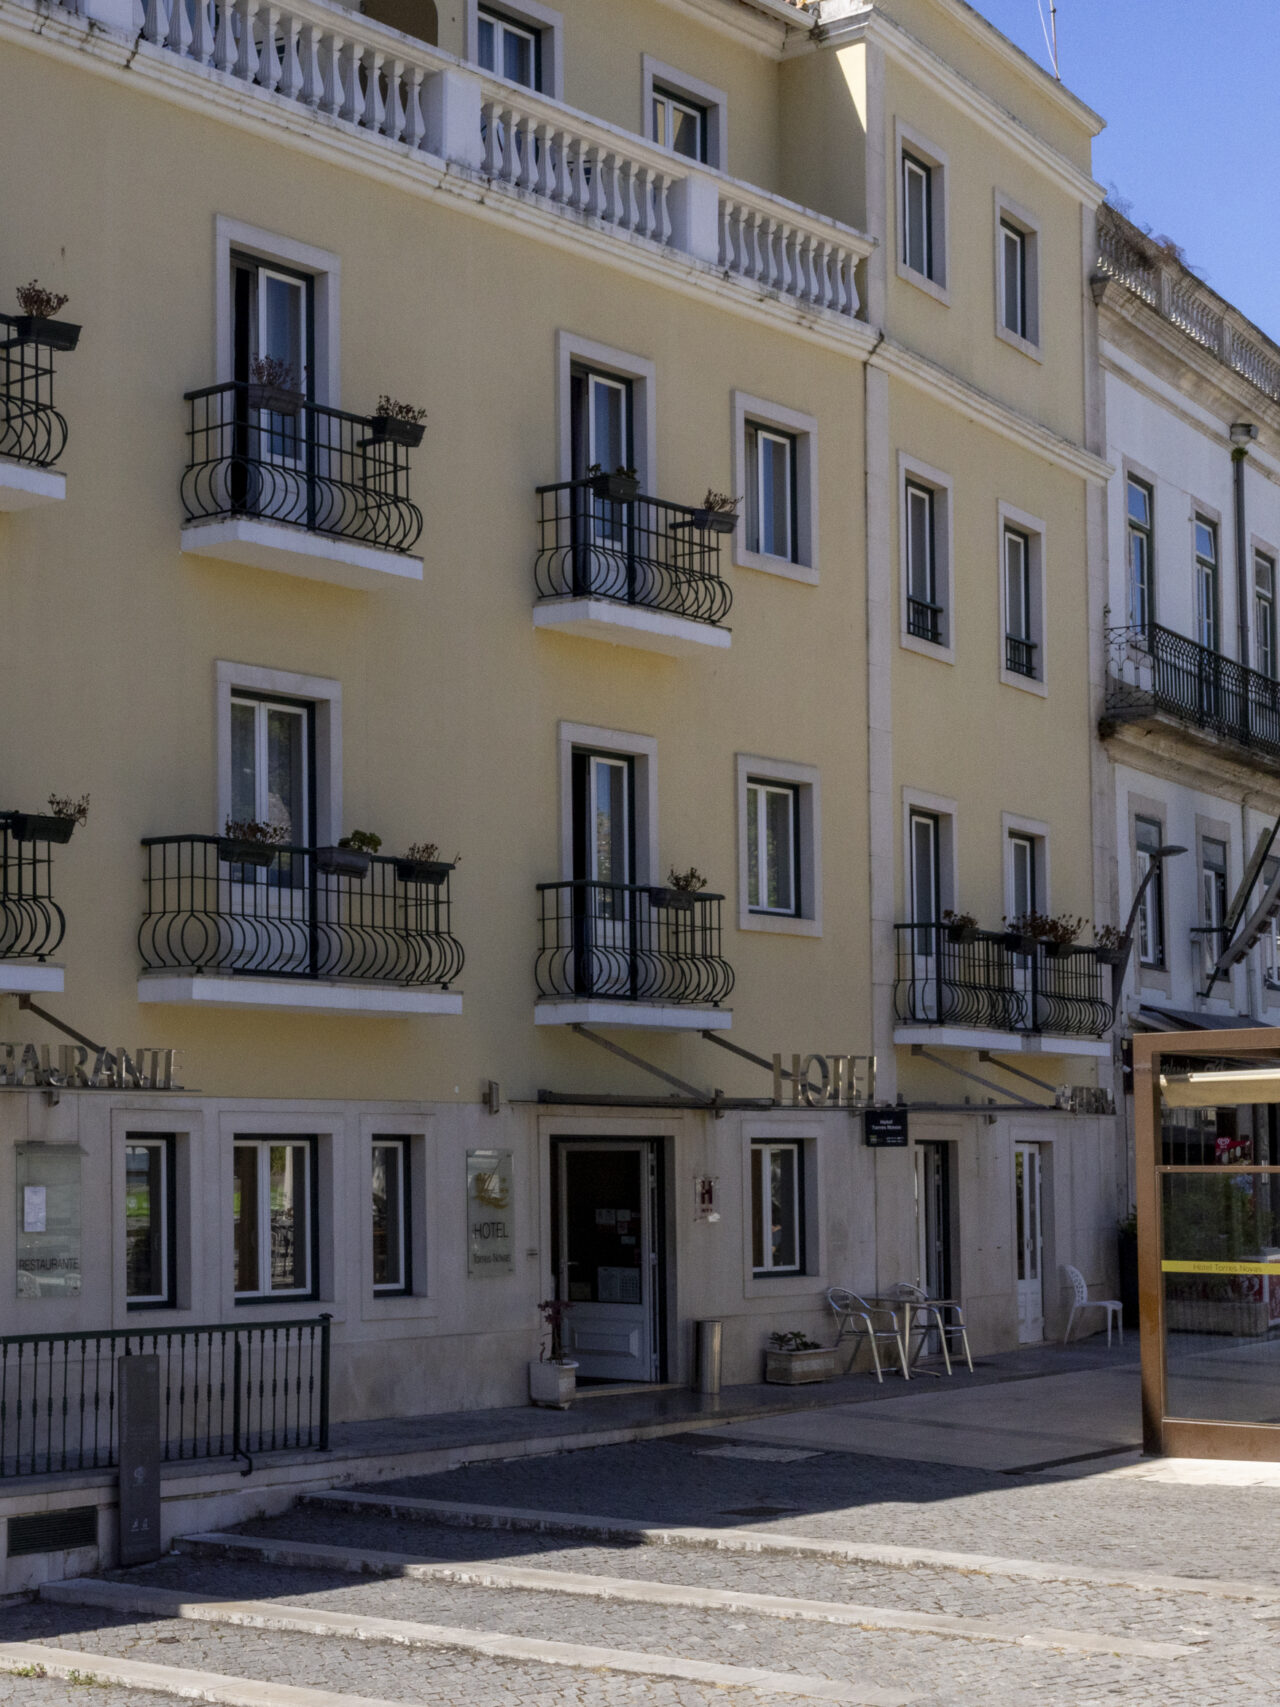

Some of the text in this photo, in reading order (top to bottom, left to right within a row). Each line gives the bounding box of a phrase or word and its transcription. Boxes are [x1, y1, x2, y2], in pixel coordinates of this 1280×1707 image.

[772, 1053, 882, 1107] HOTEL
[474, 1222, 509, 1240] HOTEL
[18, 1257, 79, 1271] RESTAURANTE
